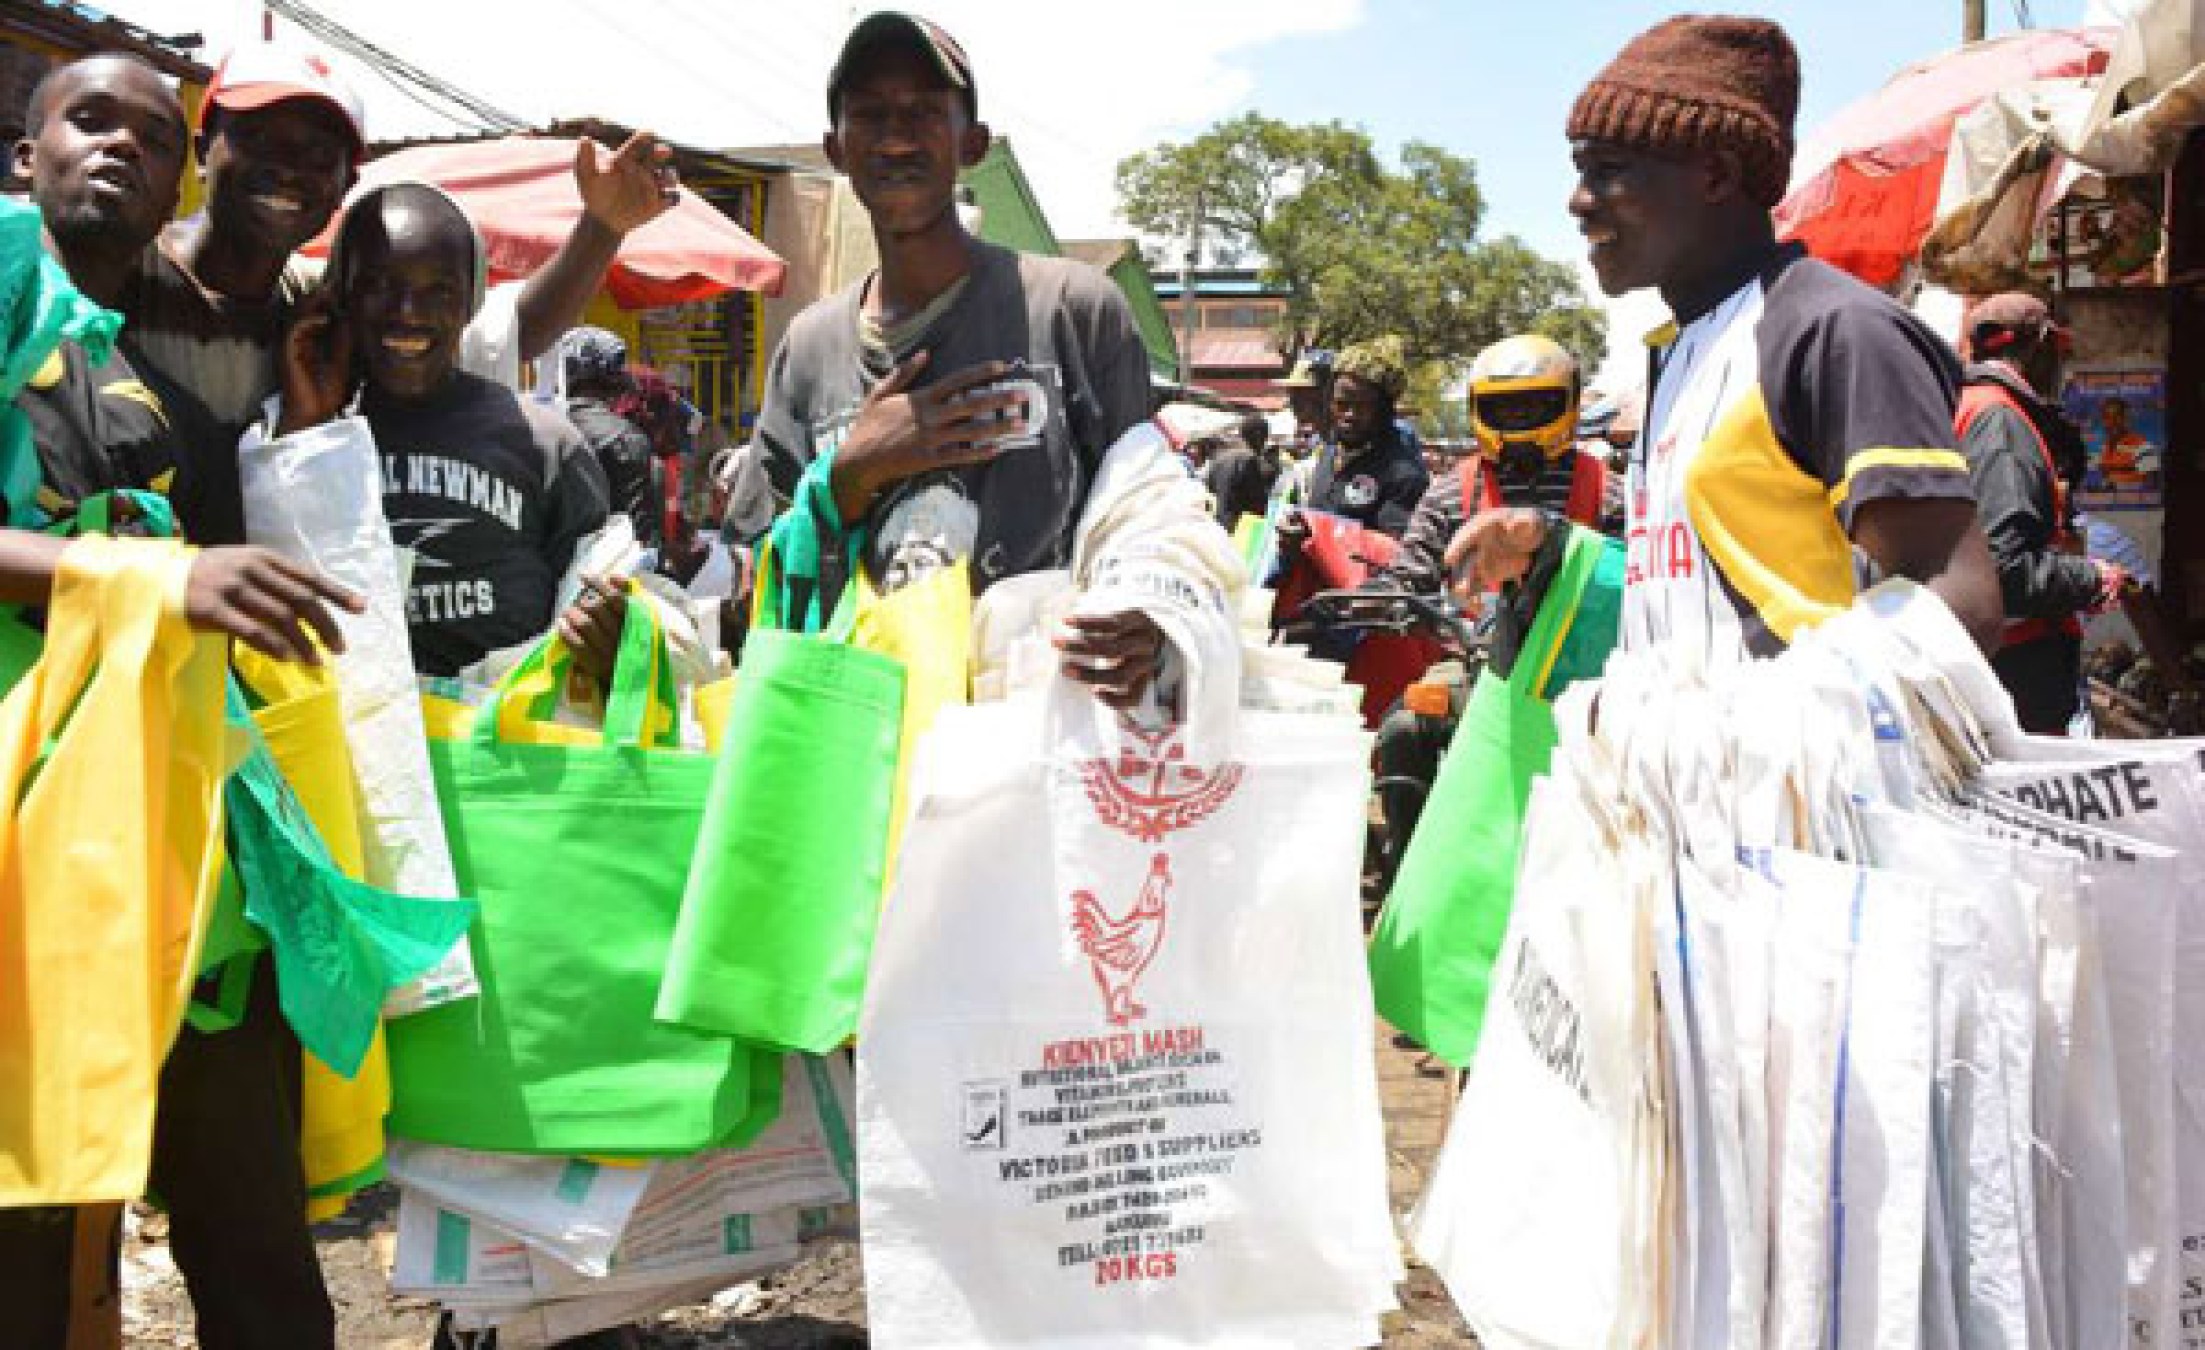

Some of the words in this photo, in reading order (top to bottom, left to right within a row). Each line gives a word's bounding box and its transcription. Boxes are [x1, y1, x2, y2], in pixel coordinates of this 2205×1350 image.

[407, 455, 523, 531] NEWMAN
[999, 1155, 1089, 1180] VICTORIA
[1157, 1128, 1262, 1157] SUPPLIERS
